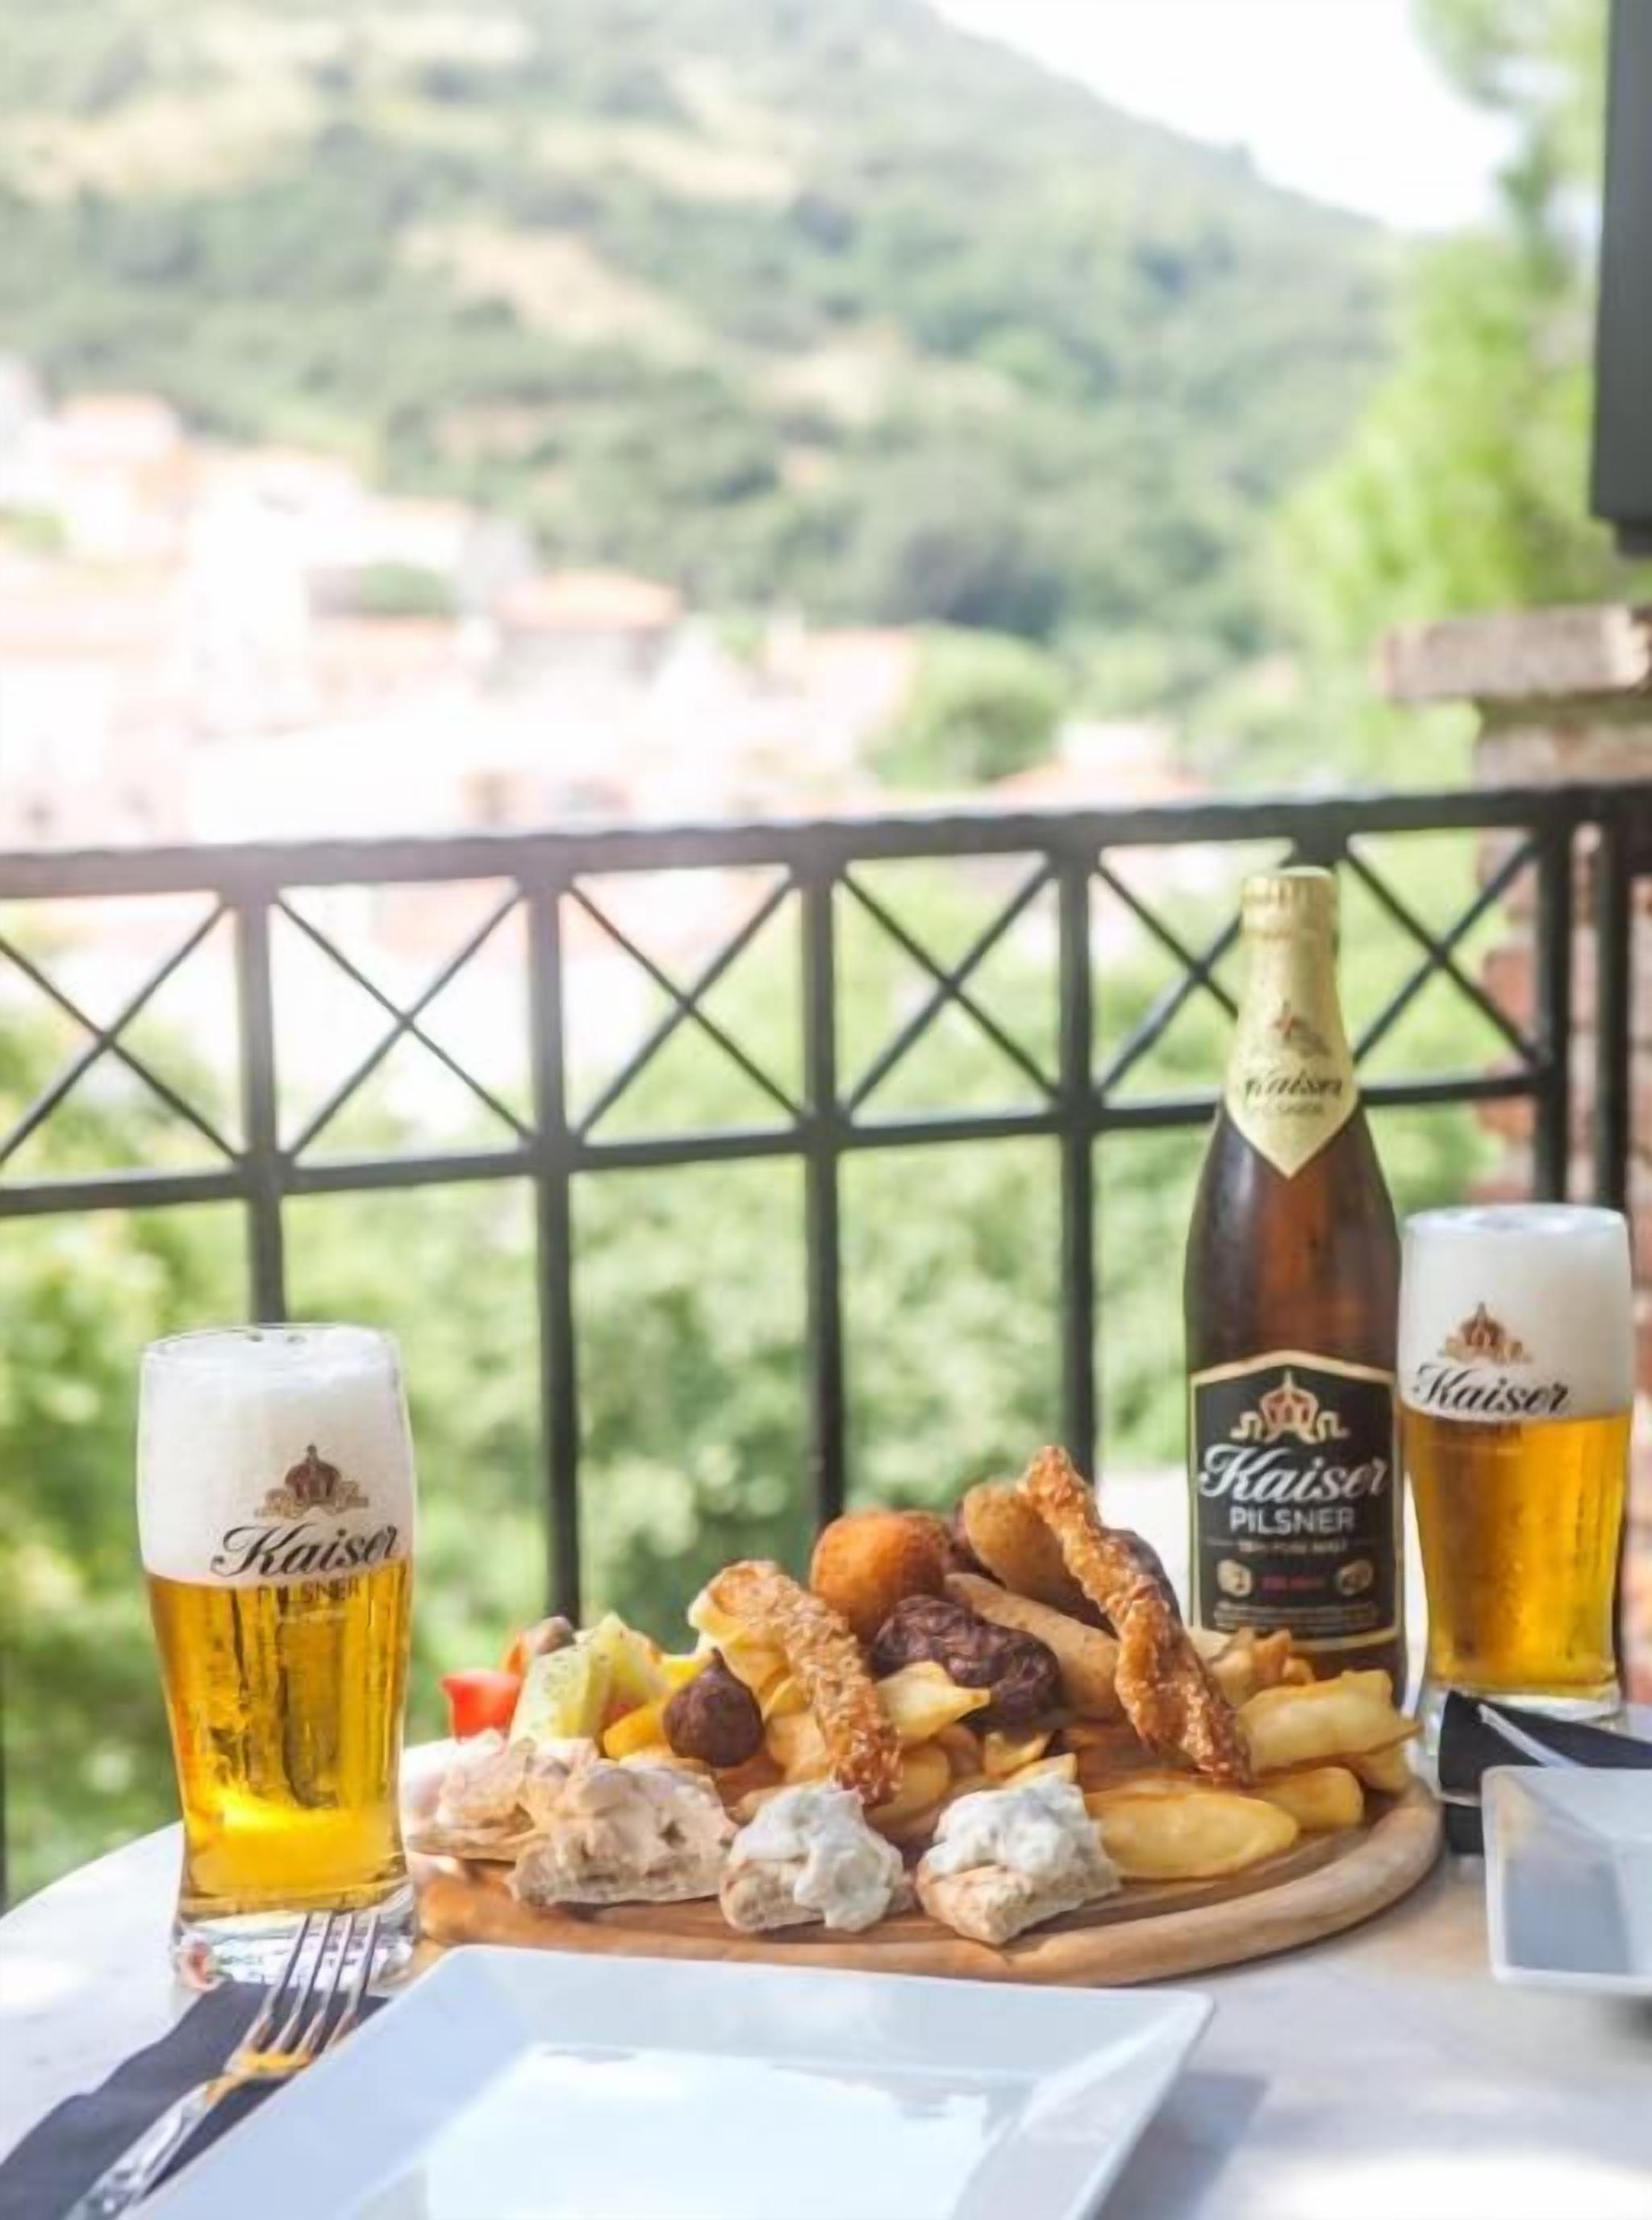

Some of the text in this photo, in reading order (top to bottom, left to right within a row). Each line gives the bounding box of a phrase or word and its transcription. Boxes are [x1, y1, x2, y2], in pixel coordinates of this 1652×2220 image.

[1412, 1362, 1569, 1413] Kaiser
[1197, 1443, 1388, 1504] Kaiser
[1229, 1505, 1356, 1536] PILSNER
[210, 1521, 398, 1578] Kaiser
